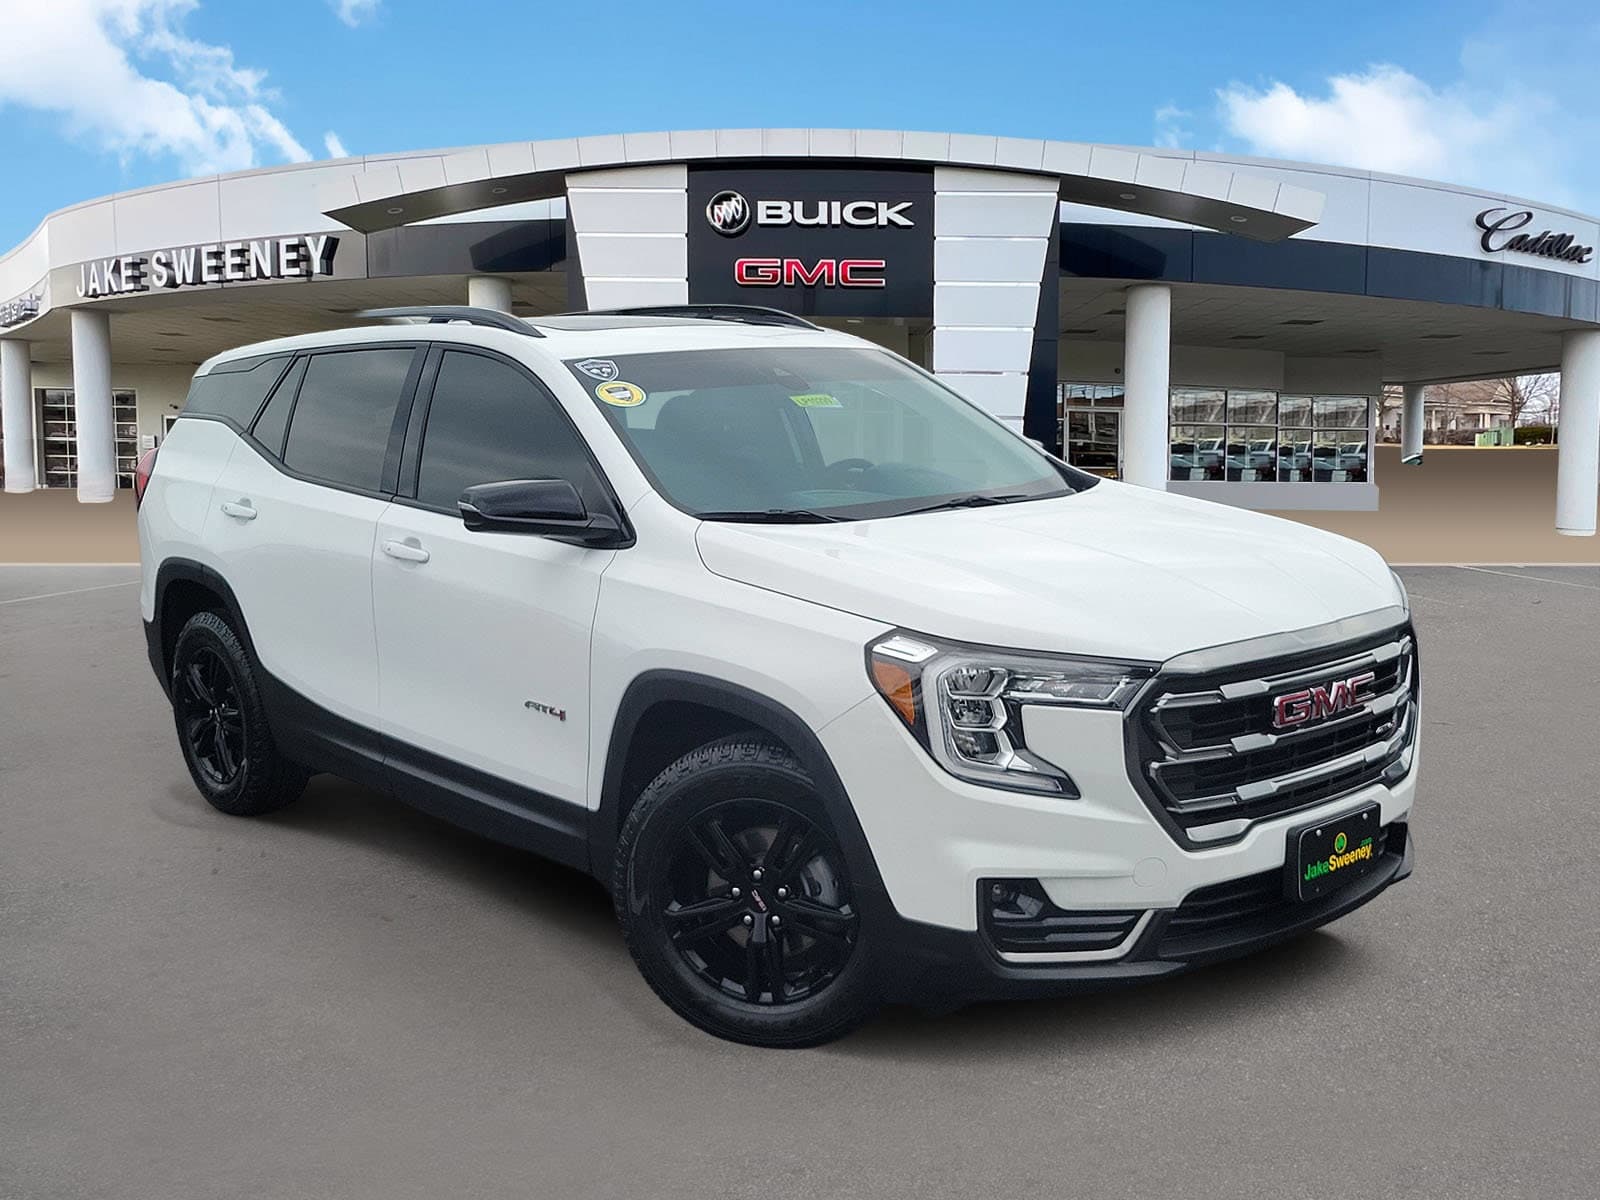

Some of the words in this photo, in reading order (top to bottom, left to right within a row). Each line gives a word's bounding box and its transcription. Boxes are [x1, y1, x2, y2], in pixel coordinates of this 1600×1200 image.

[757, 200, 915, 226] BUICK
[1475, 207, 1593, 264] Cadillac
[76, 255, 138, 298] JAKE
[151, 234, 334, 287] SWEENEY
[734, 257, 887, 287] GMC
[1273, 671, 1376, 729] GMC
